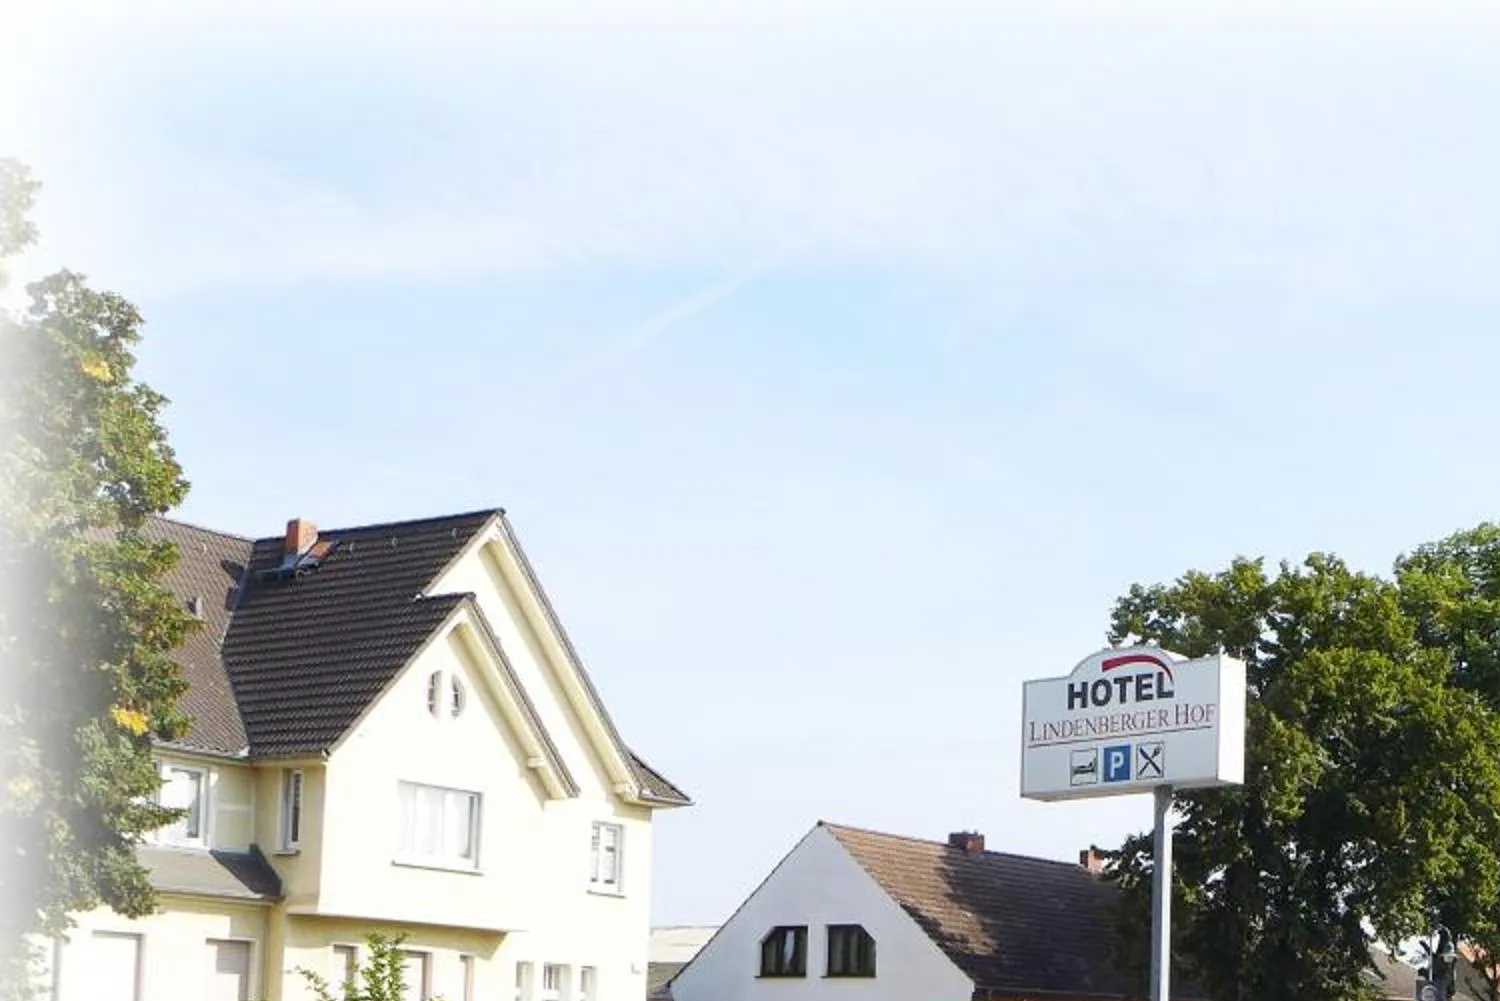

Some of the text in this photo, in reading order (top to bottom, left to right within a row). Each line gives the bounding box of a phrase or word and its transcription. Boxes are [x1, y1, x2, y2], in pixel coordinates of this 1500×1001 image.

[1067, 672, 1175, 710] HOTEL
[1028, 703, 1217, 742] LINDENBERGER HOF
[1110, 751, 1124, 777] P
